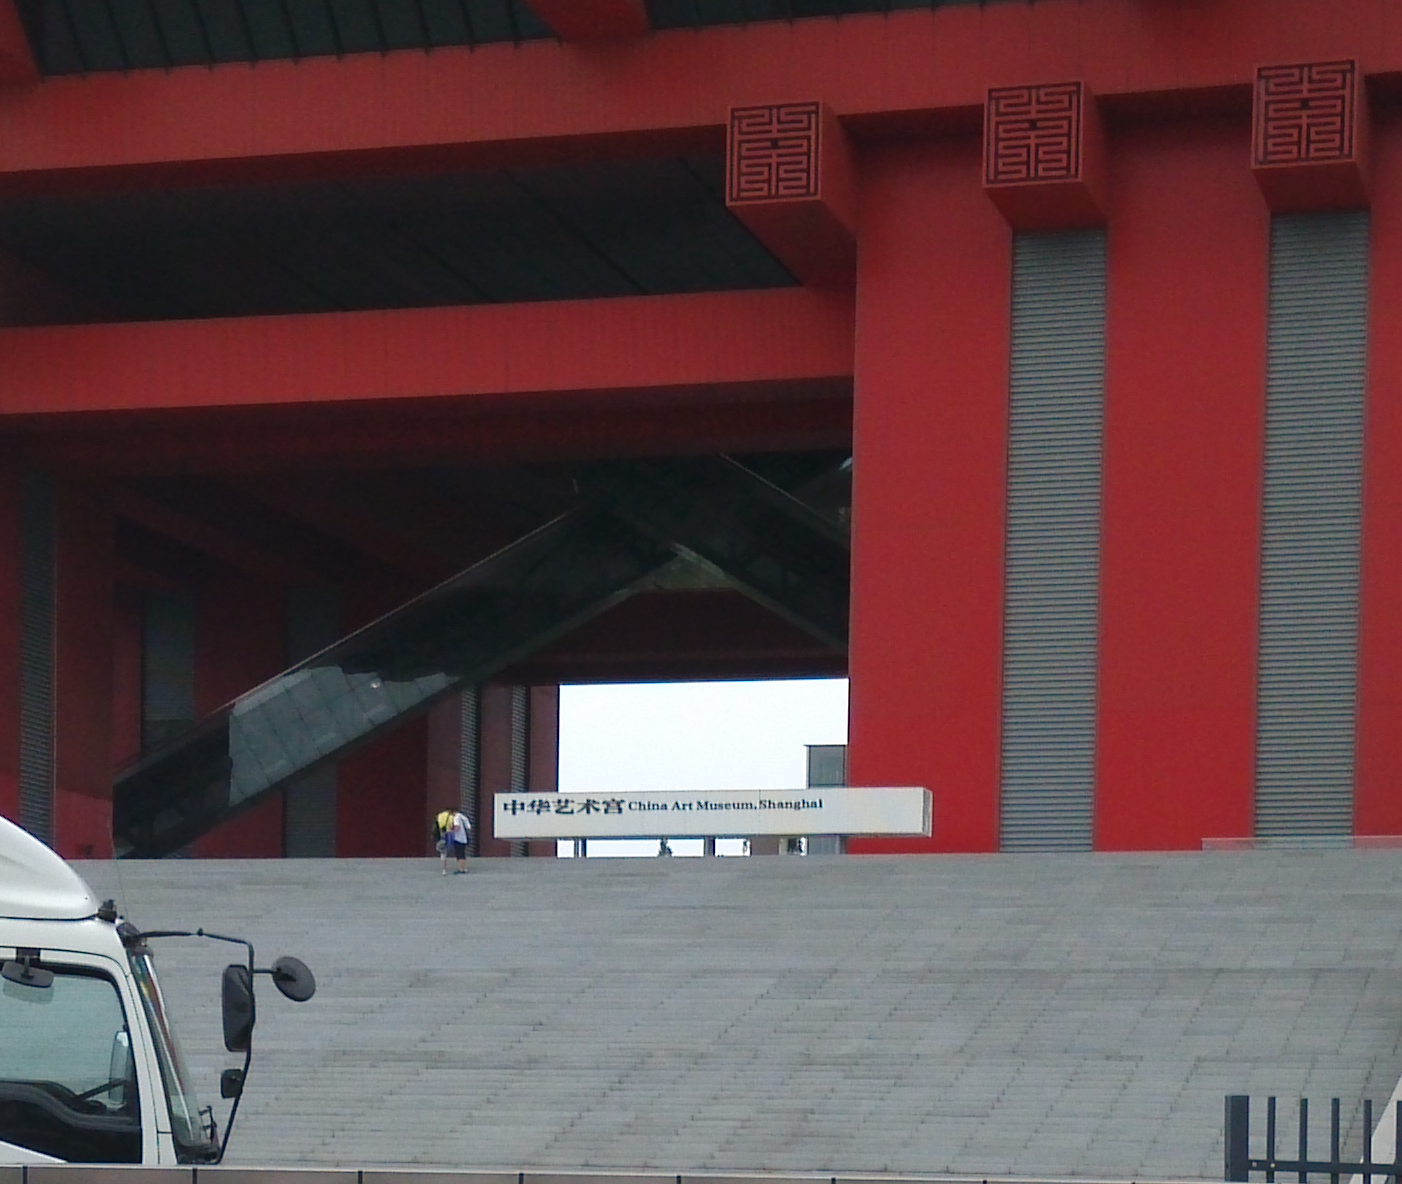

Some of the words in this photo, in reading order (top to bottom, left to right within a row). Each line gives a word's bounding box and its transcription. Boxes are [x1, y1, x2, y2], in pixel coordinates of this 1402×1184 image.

[503, 797, 625, 816] 中华艺术宫
[628, 800, 668, 811] China
[672, 800, 694, 811] Art
